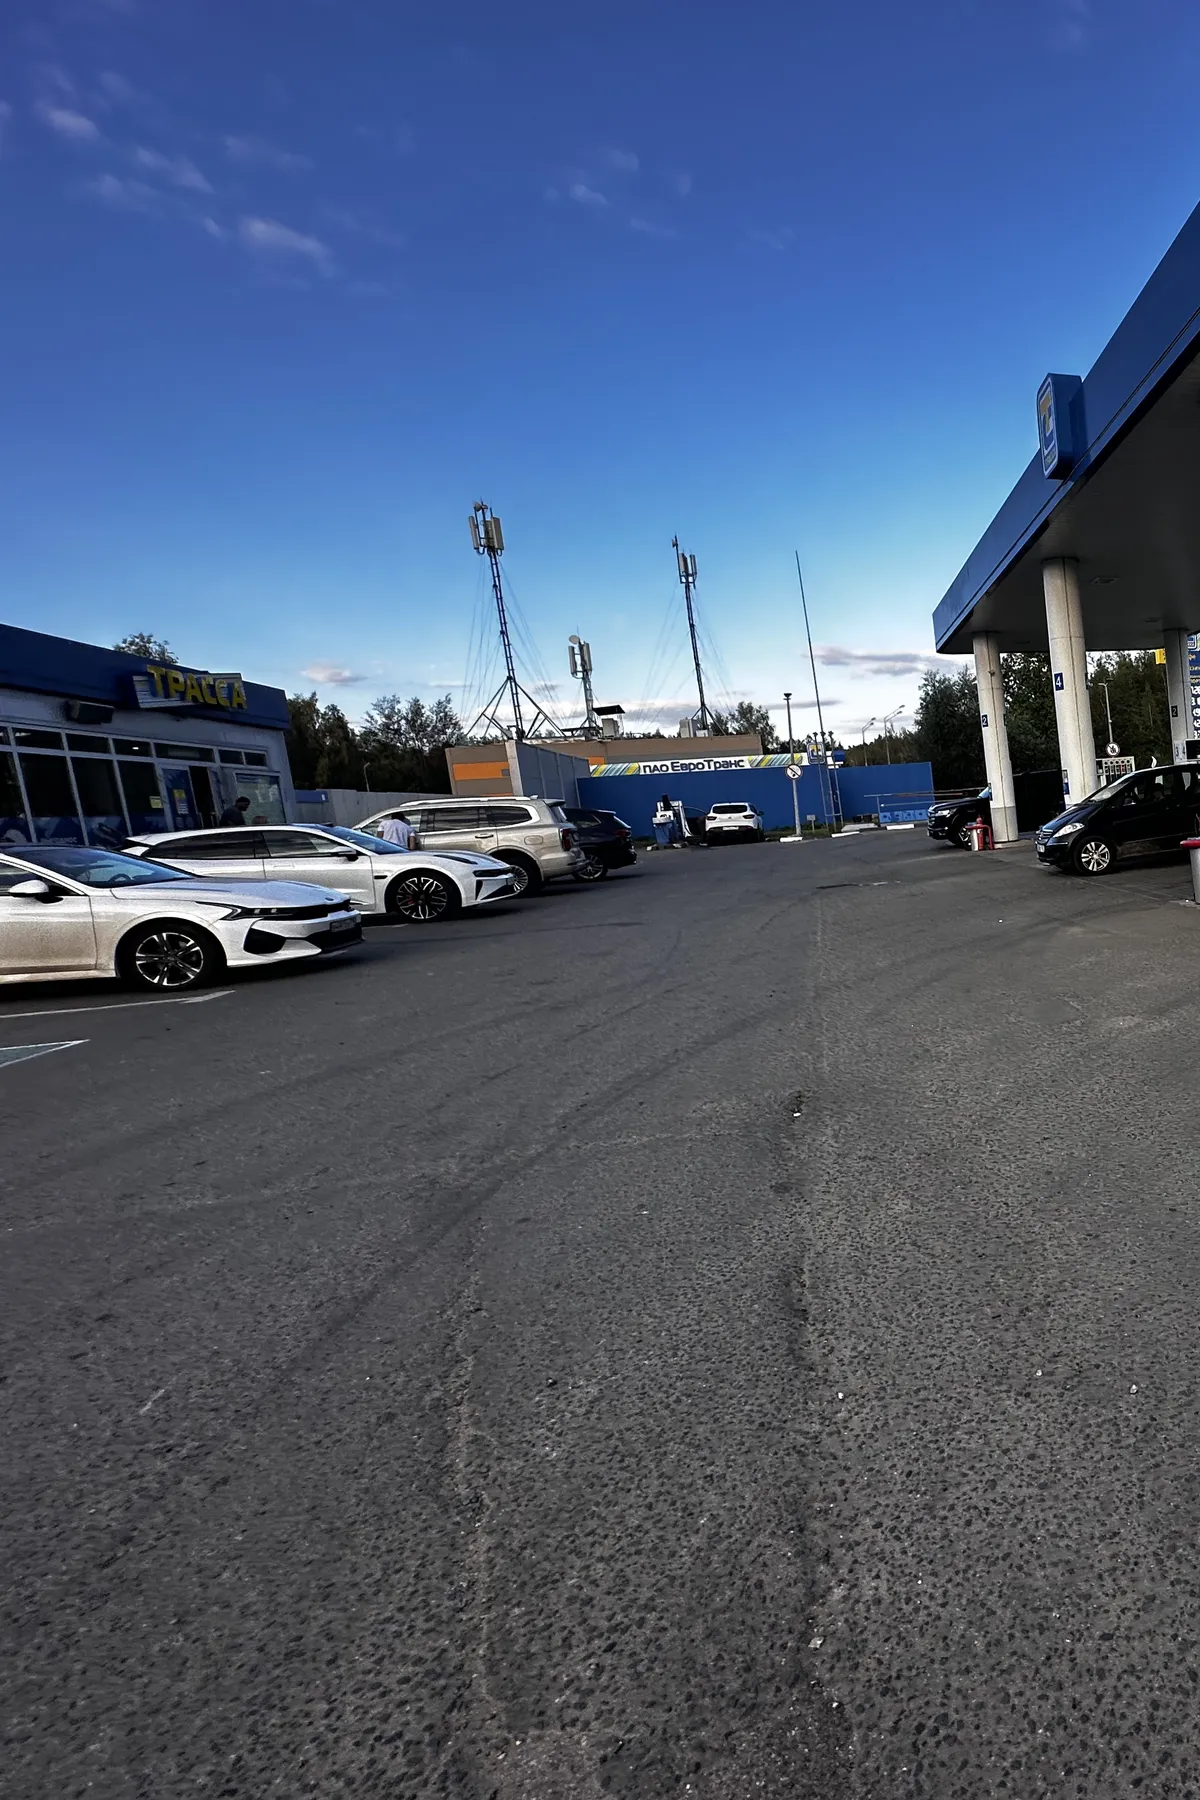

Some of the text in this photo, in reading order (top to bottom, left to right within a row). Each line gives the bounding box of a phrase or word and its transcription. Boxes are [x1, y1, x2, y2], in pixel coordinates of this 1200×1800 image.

[146, 664, 248, 709] ТРАССА
[1055, 676, 1062, 688] 4
[643, 758, 745, 774] ПАО ЕвроТранс
